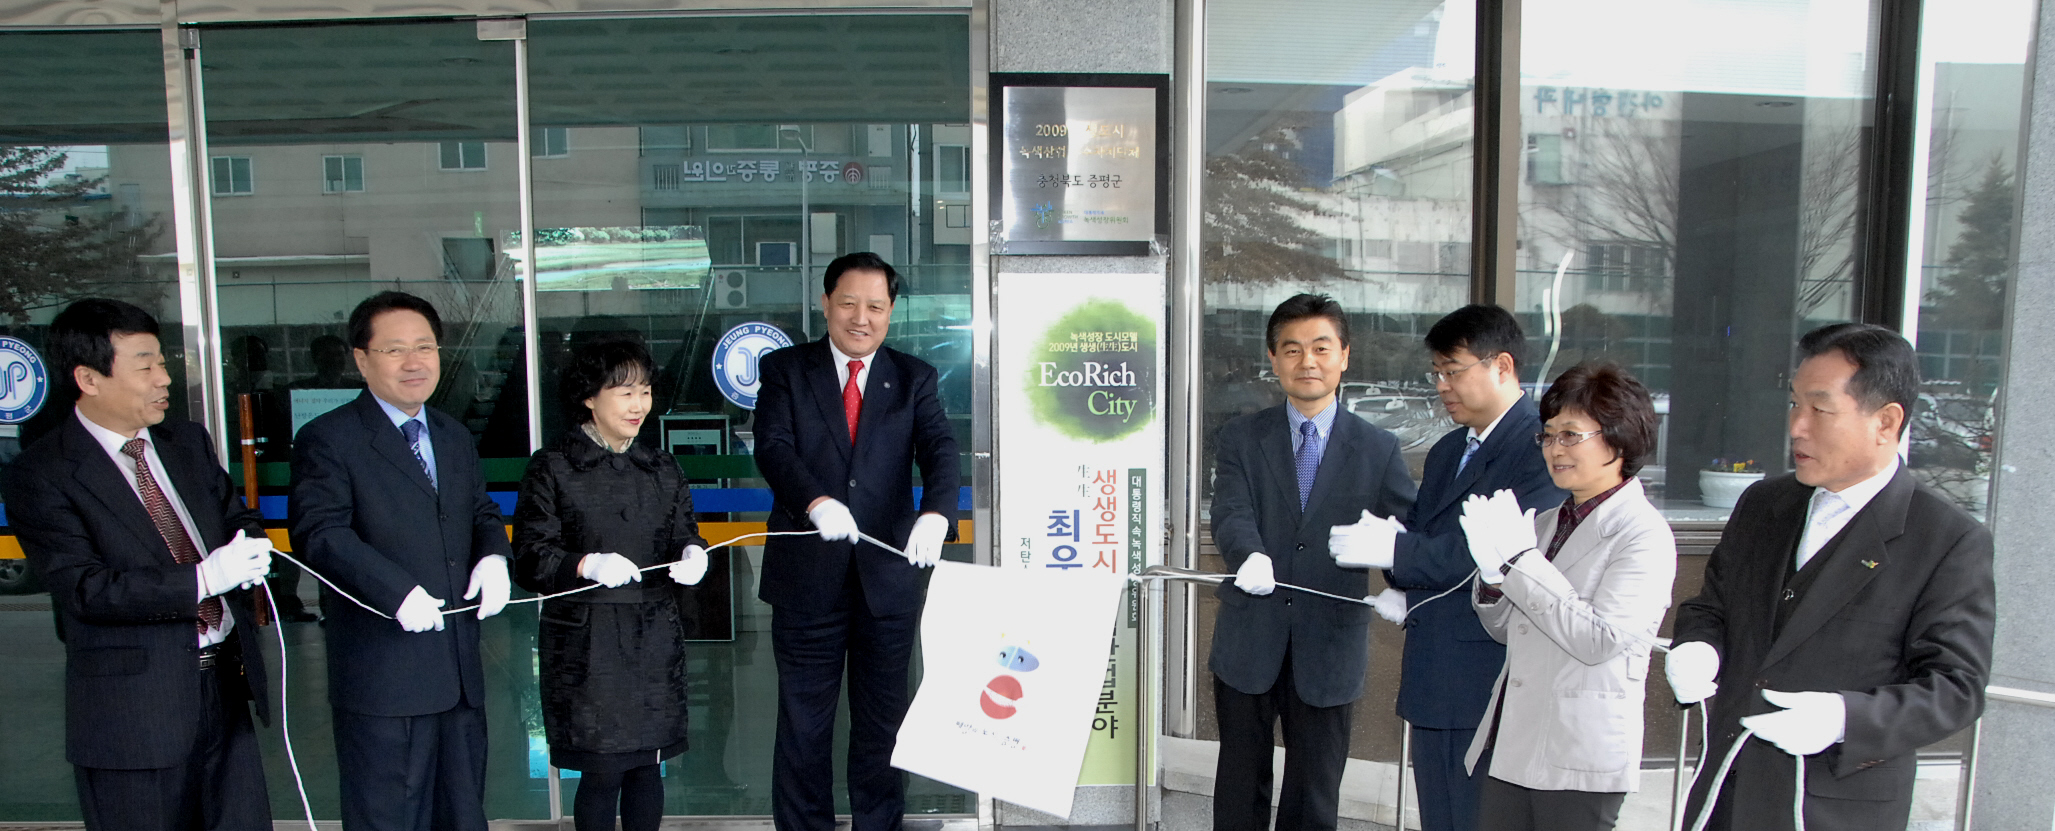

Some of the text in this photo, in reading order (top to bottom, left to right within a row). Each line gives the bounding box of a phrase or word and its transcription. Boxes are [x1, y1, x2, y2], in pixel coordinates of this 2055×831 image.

[1035, 124, 1068, 137] 2009
[1019, 145, 1068, 159] 녹색산업
[1036, 174, 1123, 189] 충청북도 증평군
[722, 325, 790, 350] JEUNG PYEONG
[1048, 342, 1079, 353] 2009년
[1070, 331, 1138, 342] 녹색성장 도시모델
[2, 340, 37, 364] PYEONG
[1038, 361, 1137, 387] EcoRich
[1087, 390, 1138, 424] City
[1092, 469, 1119, 574] 생생도시
[1020, 537, 1031, 569] 저탄
